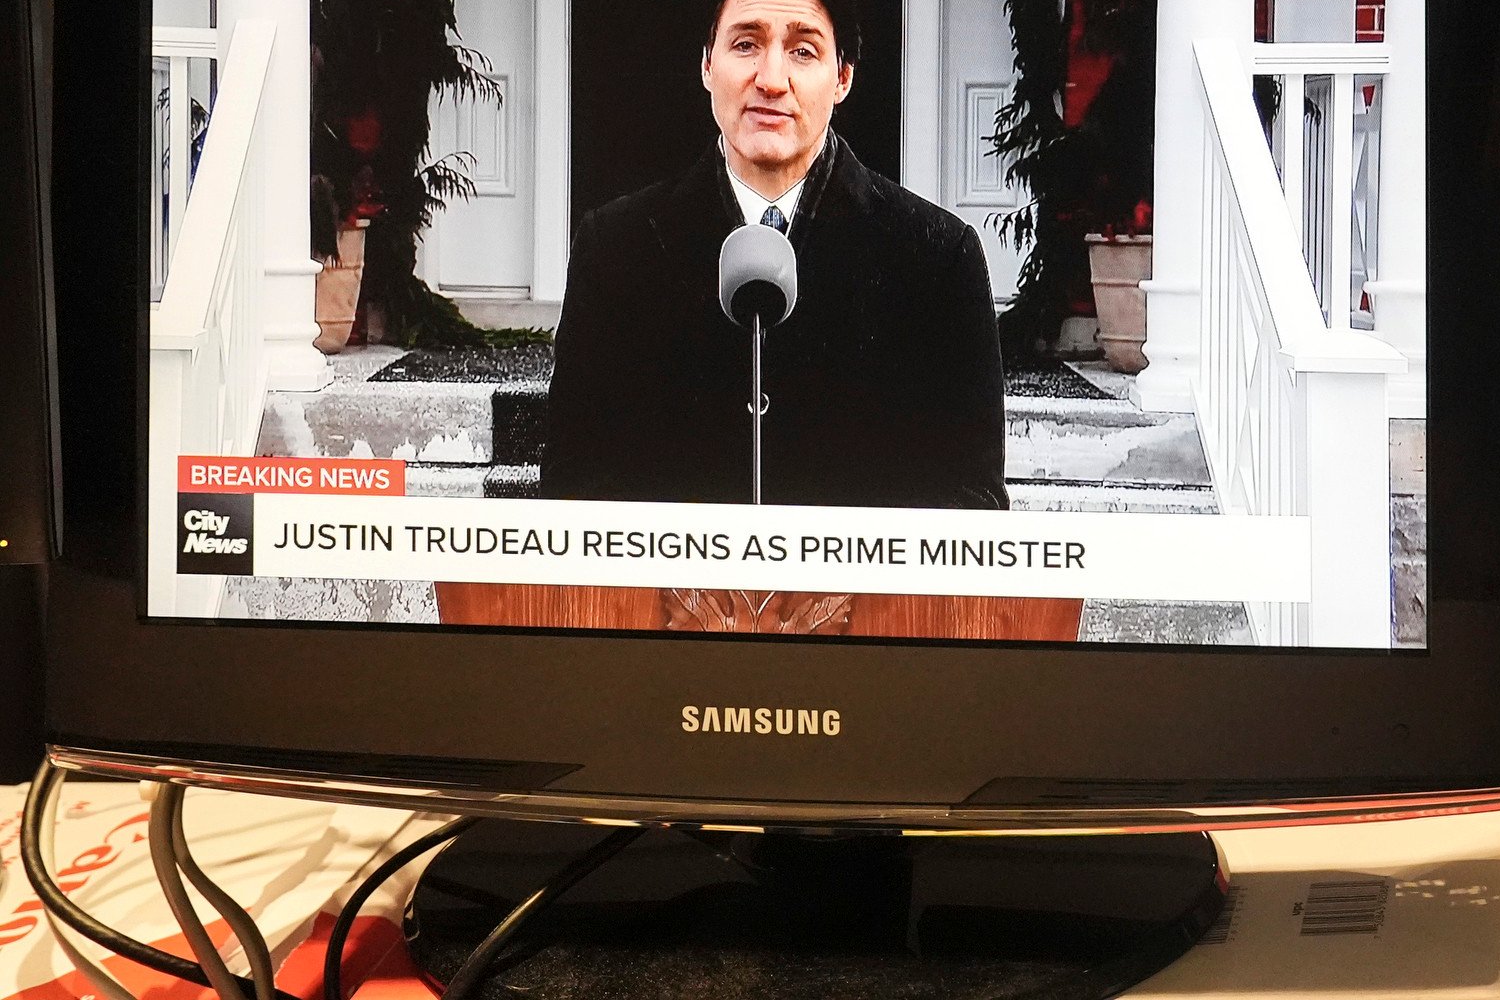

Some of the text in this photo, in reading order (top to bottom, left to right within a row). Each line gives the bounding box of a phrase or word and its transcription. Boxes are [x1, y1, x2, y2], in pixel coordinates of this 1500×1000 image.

[191, 465, 390, 489] BREAKING NEWS
[183, 510, 230, 533] City
[183, 534, 248, 555] News
[274, 523, 1086, 569] JUSTIN TRUDEAU RESIGNS AS PRIME MINISTER
[681, 705, 841, 736] SAMSUNG
